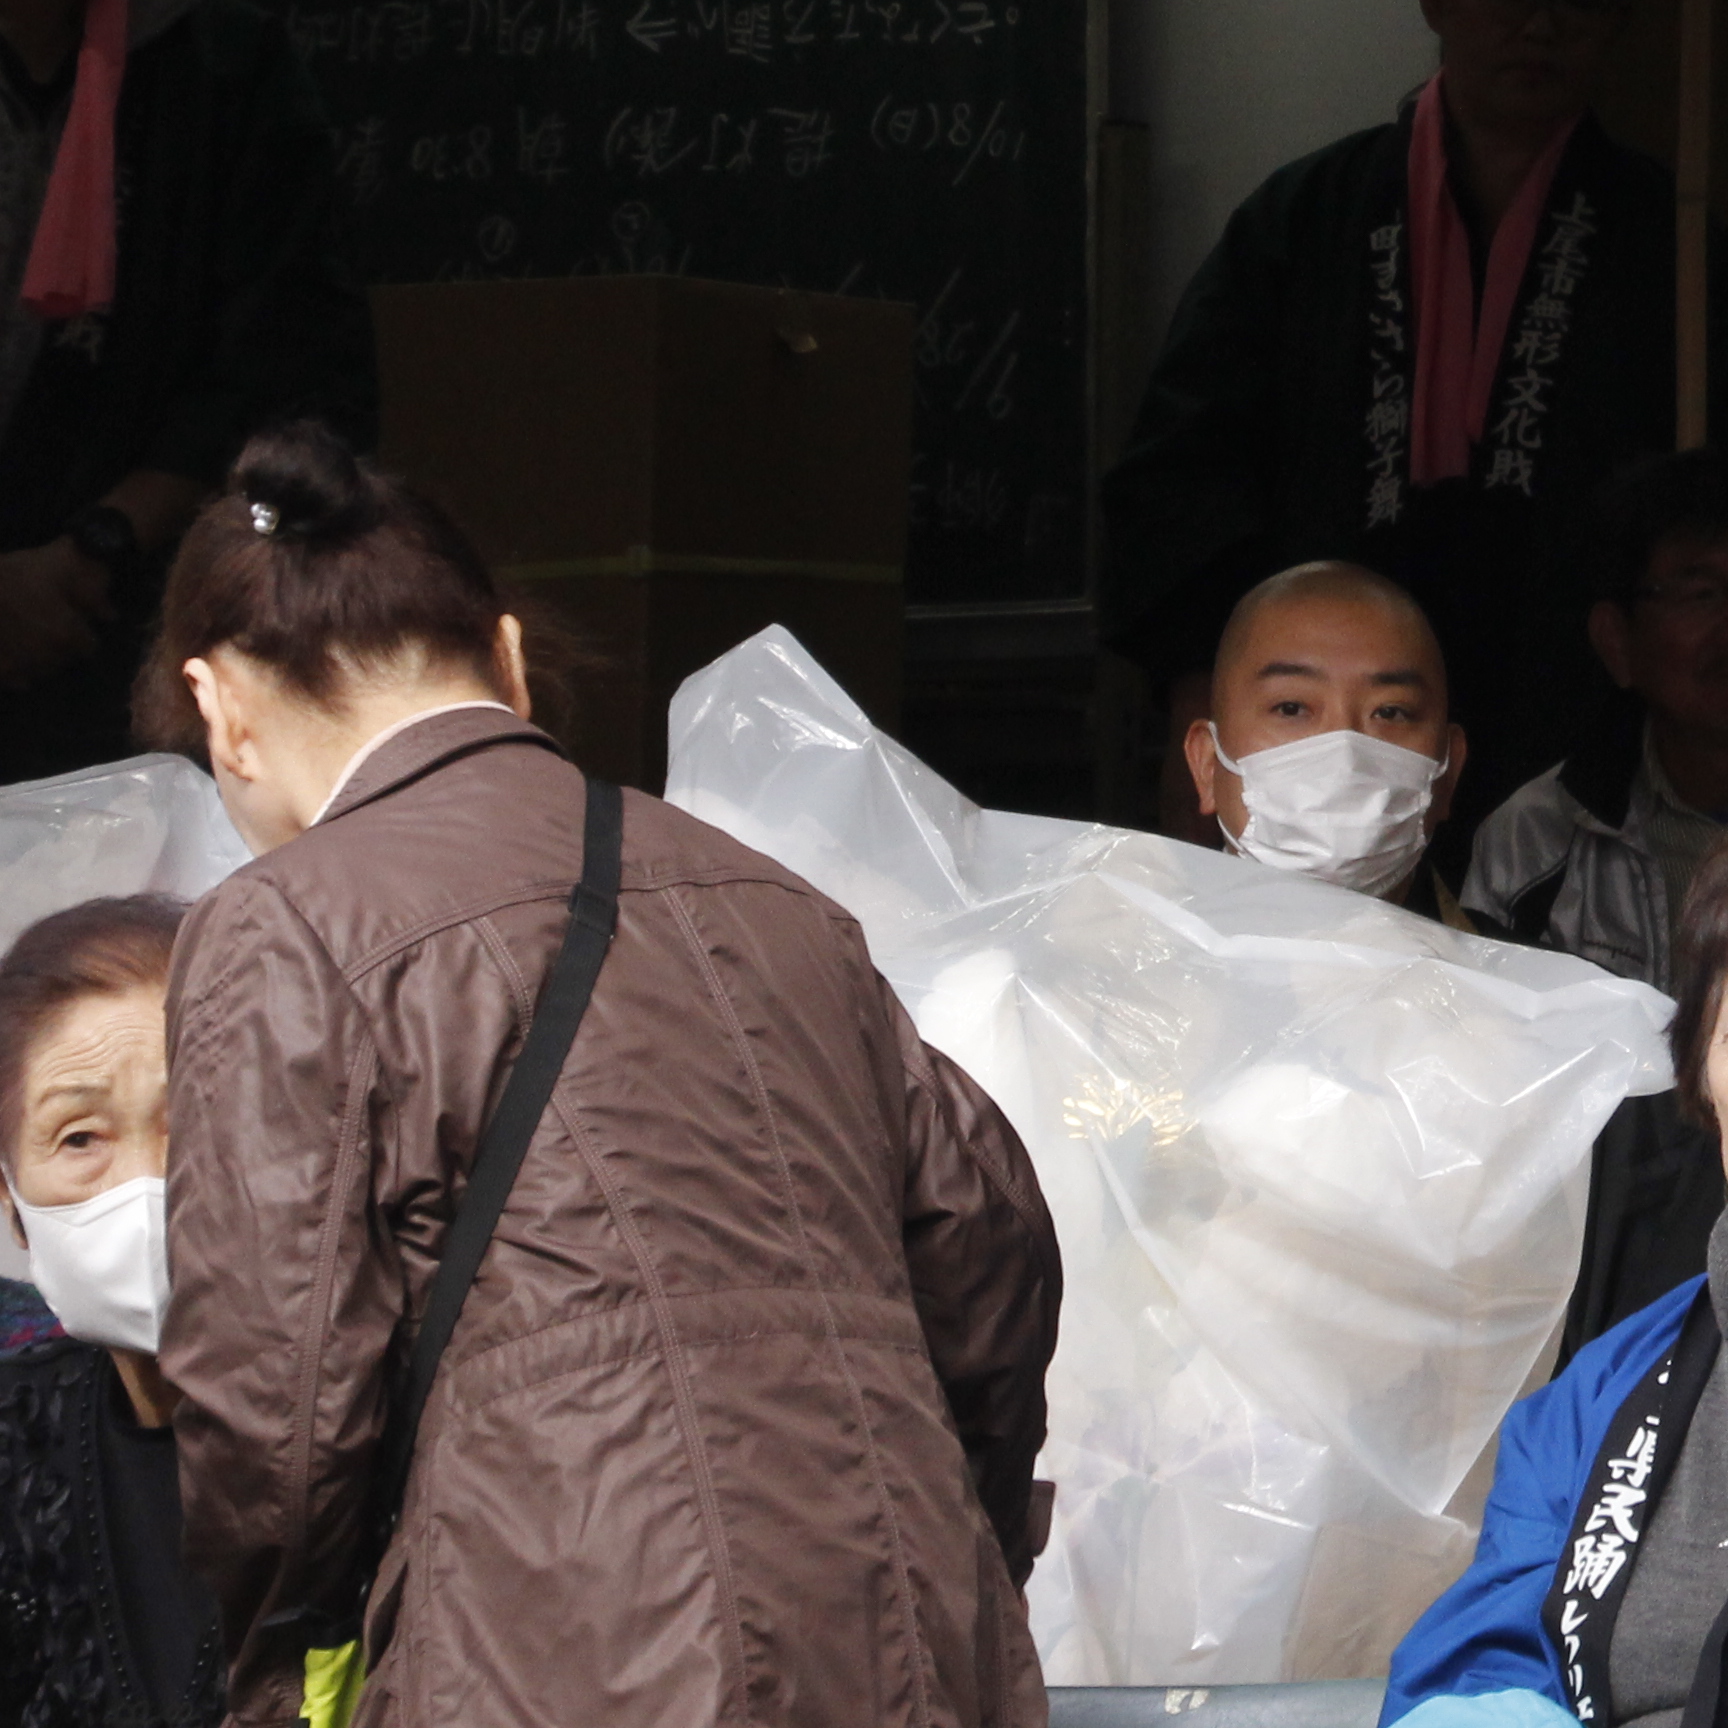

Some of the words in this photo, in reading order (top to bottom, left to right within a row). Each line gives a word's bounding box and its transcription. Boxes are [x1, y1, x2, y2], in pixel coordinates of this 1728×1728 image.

[1484, 191, 1598, 497] 上尾市無形文化財
